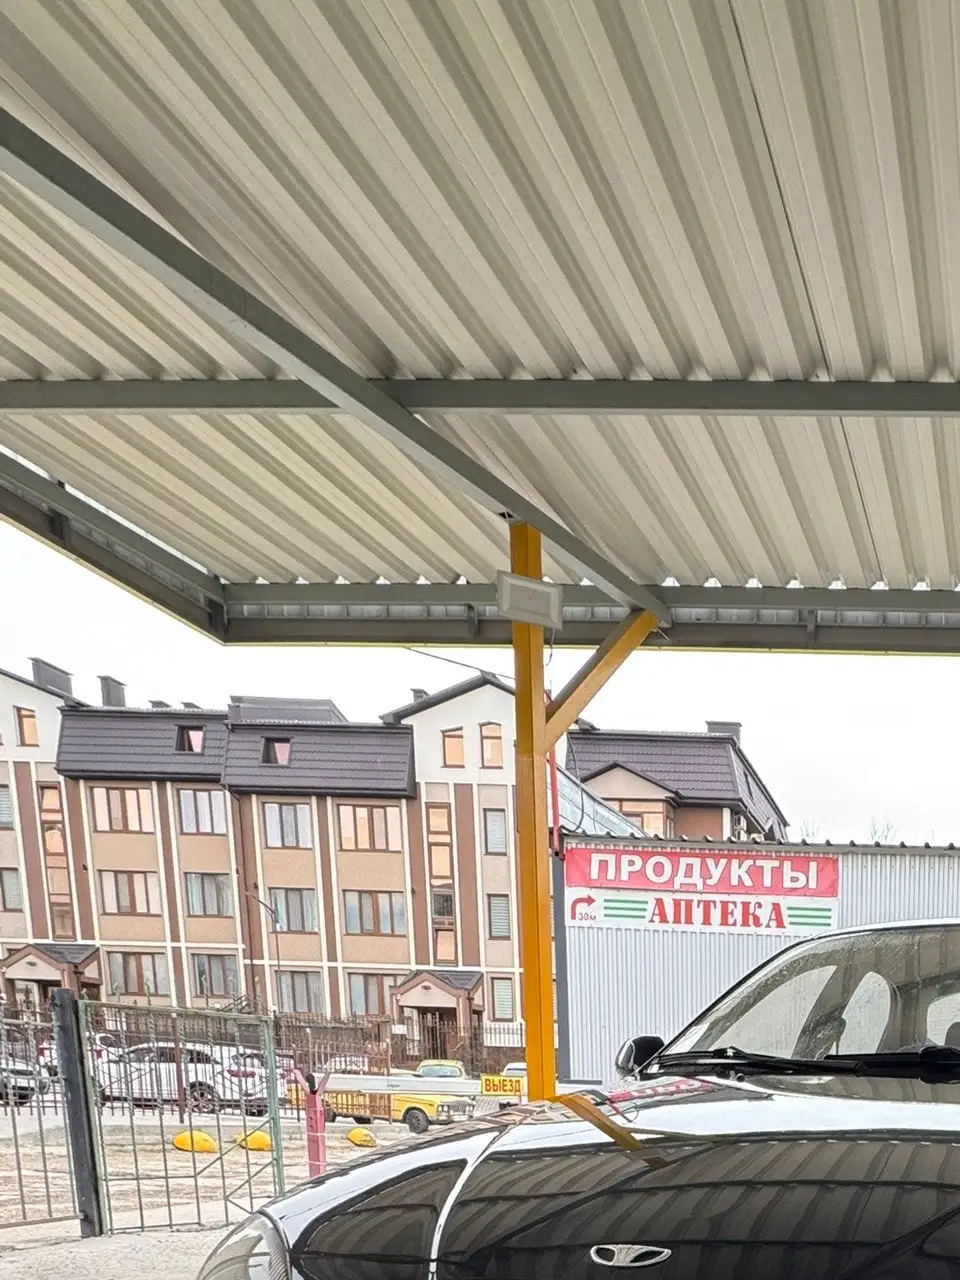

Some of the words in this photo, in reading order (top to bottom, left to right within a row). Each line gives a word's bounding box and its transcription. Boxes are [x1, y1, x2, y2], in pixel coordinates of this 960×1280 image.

[589, 852, 818, 890] ПРОДУКТЫ
[648, 897, 786, 928] АПТЕКА
[484, 1078, 521, 1094] ВЫЕЗД
